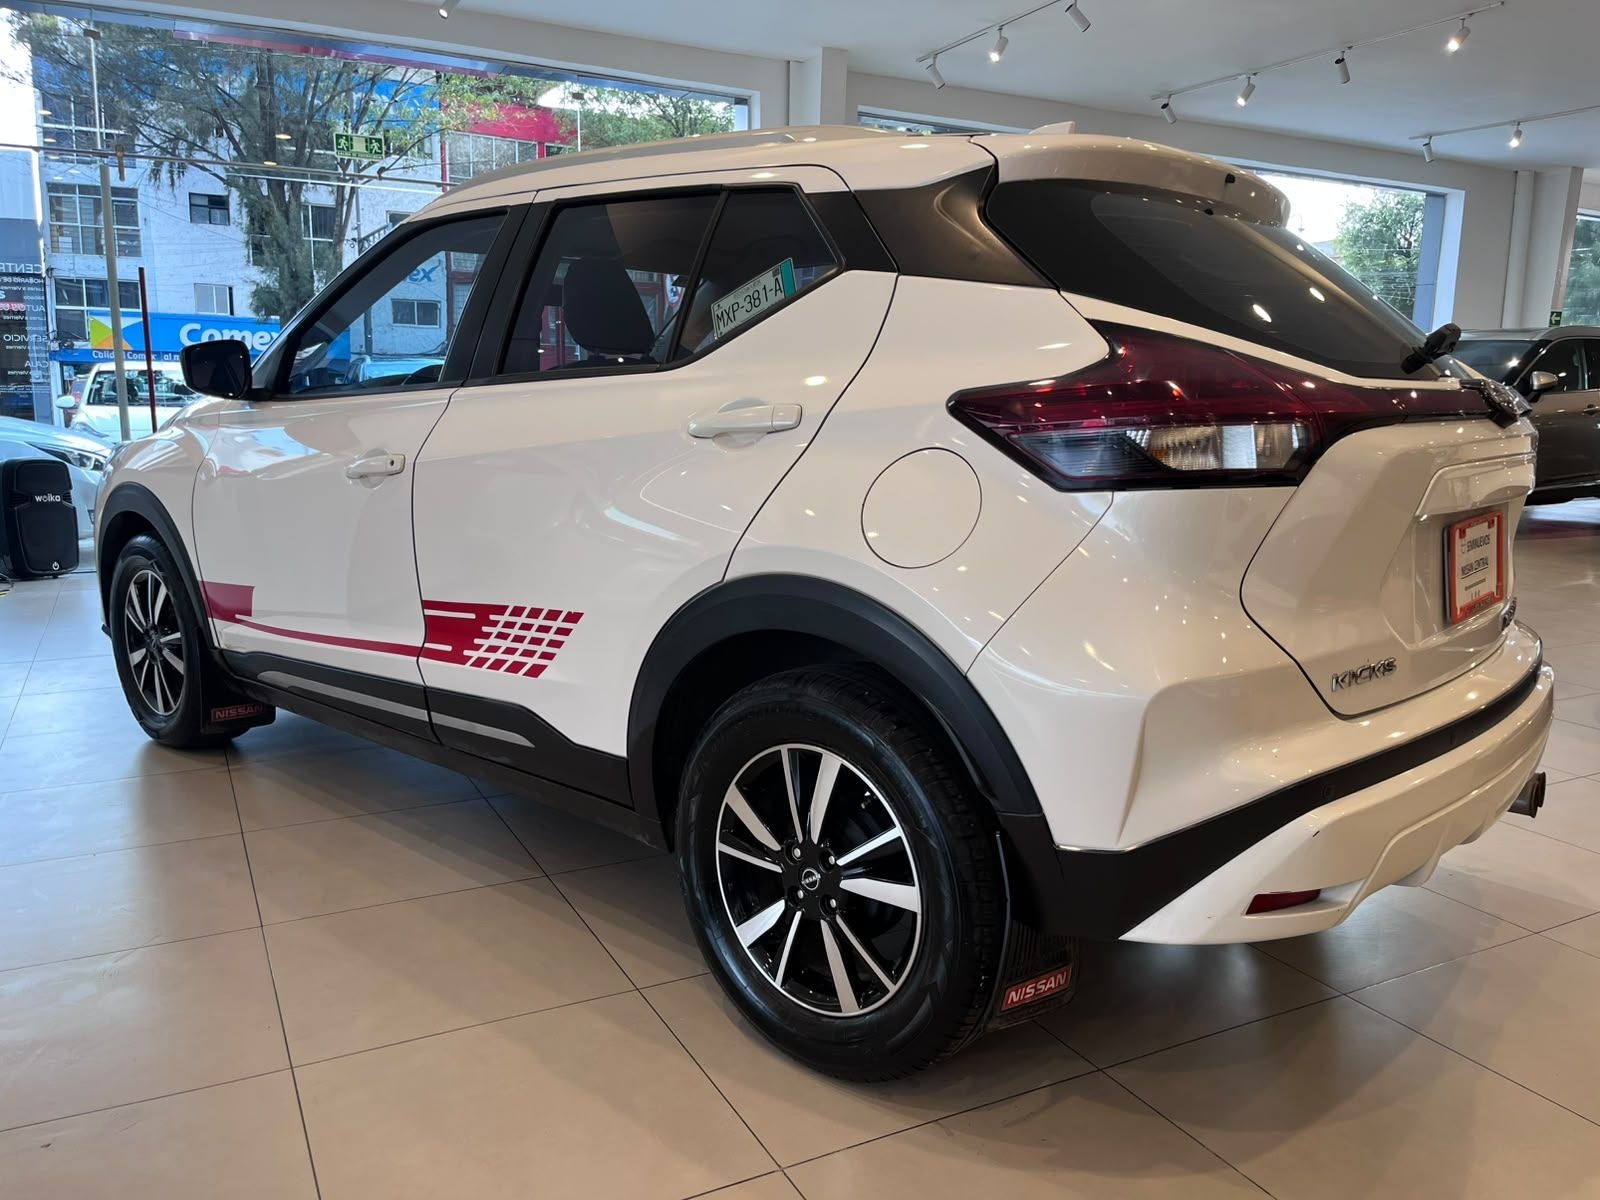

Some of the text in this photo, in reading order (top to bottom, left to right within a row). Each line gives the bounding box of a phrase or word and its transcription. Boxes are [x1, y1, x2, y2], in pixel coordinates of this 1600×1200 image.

[715, 277, 783, 331] MXP-381-A
[179, 322, 280, 352] Come
[126, 351, 157, 361] Comx
[1331, 656, 1397, 692] KICKS
[1007, 971, 1067, 1004] NISSAN
